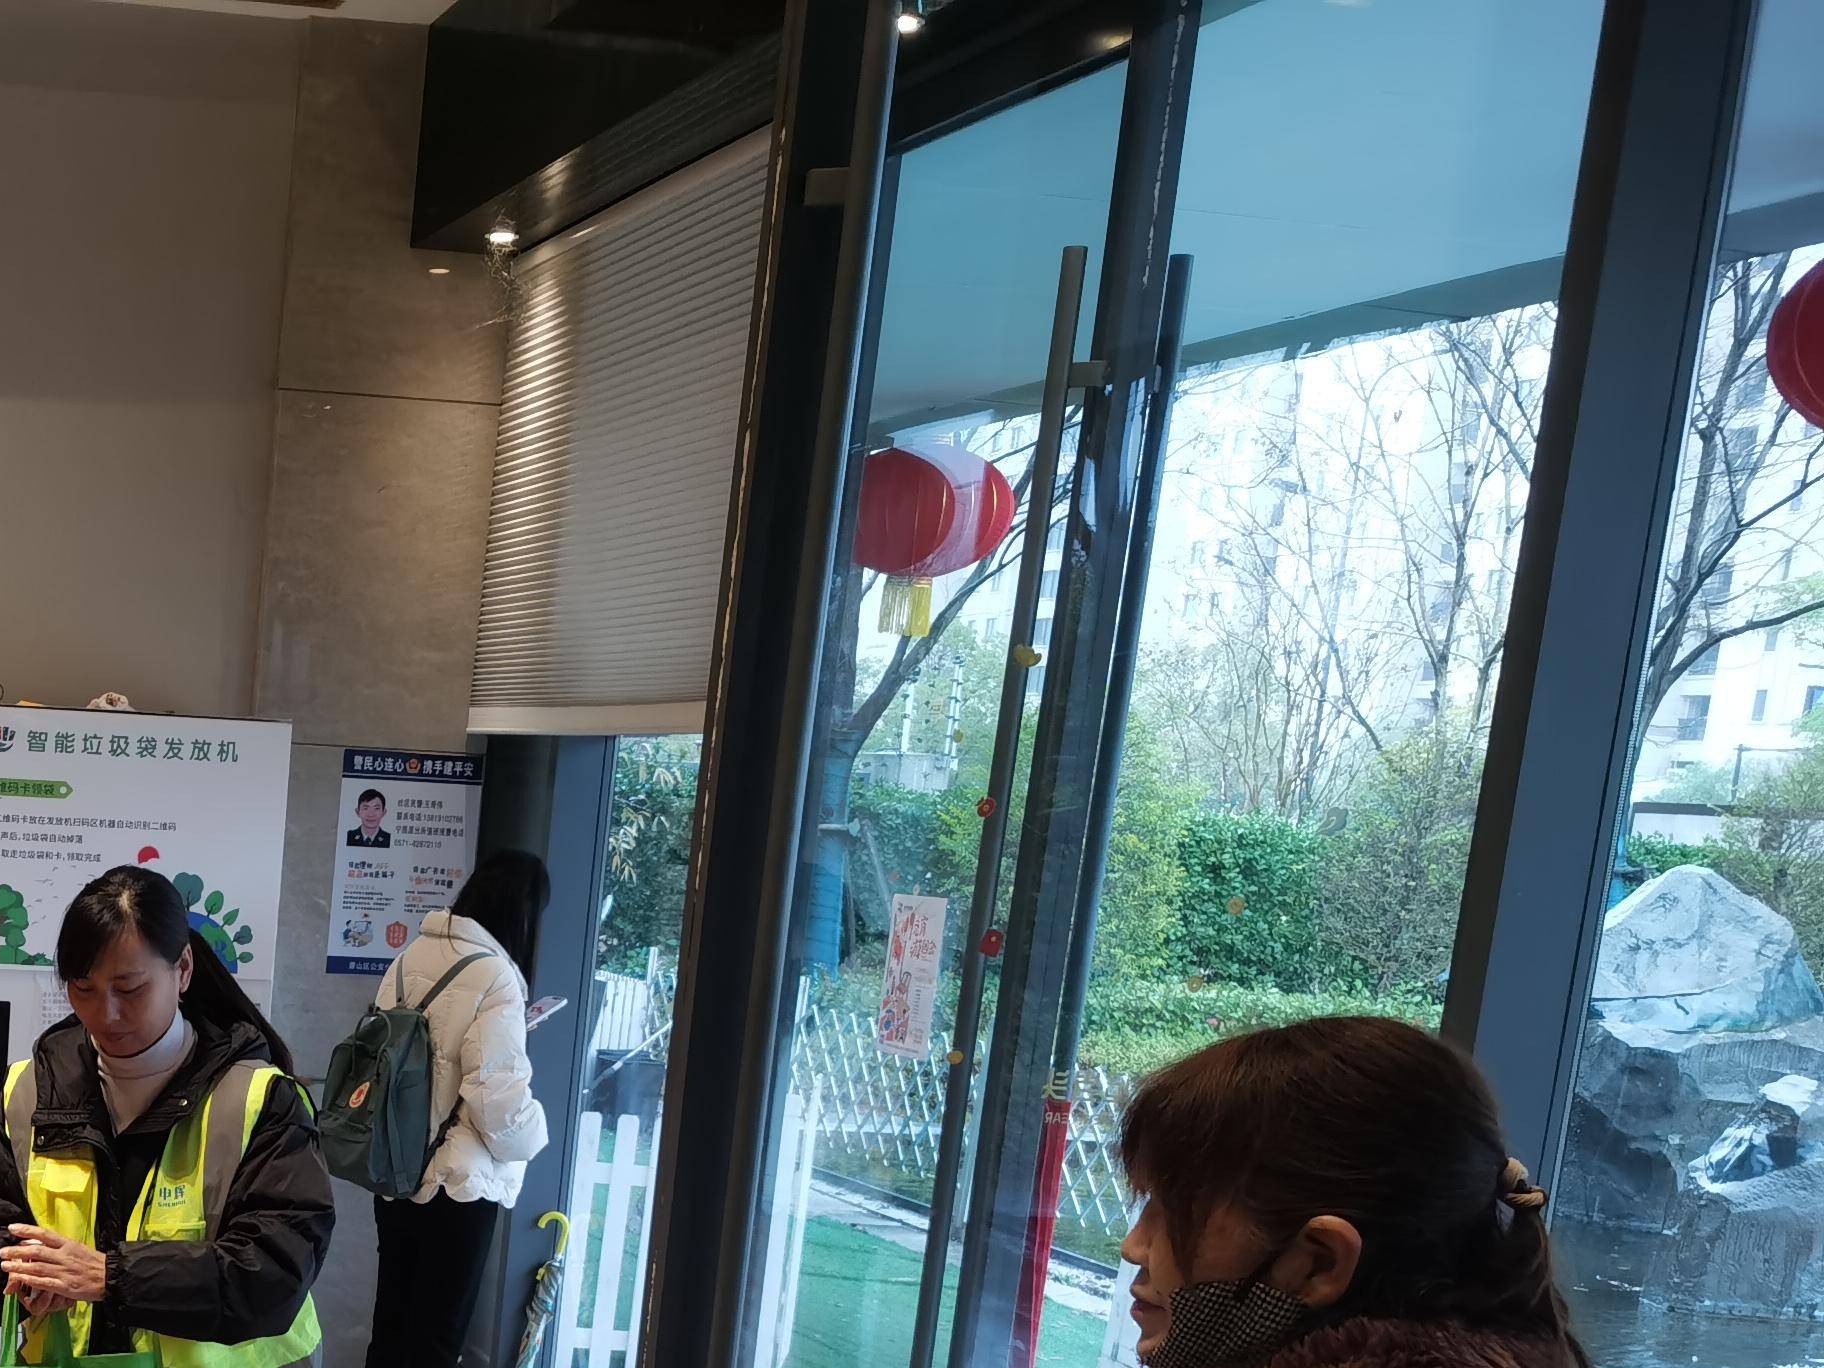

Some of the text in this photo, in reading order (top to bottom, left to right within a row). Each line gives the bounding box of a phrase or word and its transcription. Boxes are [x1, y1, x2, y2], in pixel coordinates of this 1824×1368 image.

[26, 730, 239, 763] 智能垃圾袋发放机
[353, 755, 474, 776] 警民心连心 携手建平安
